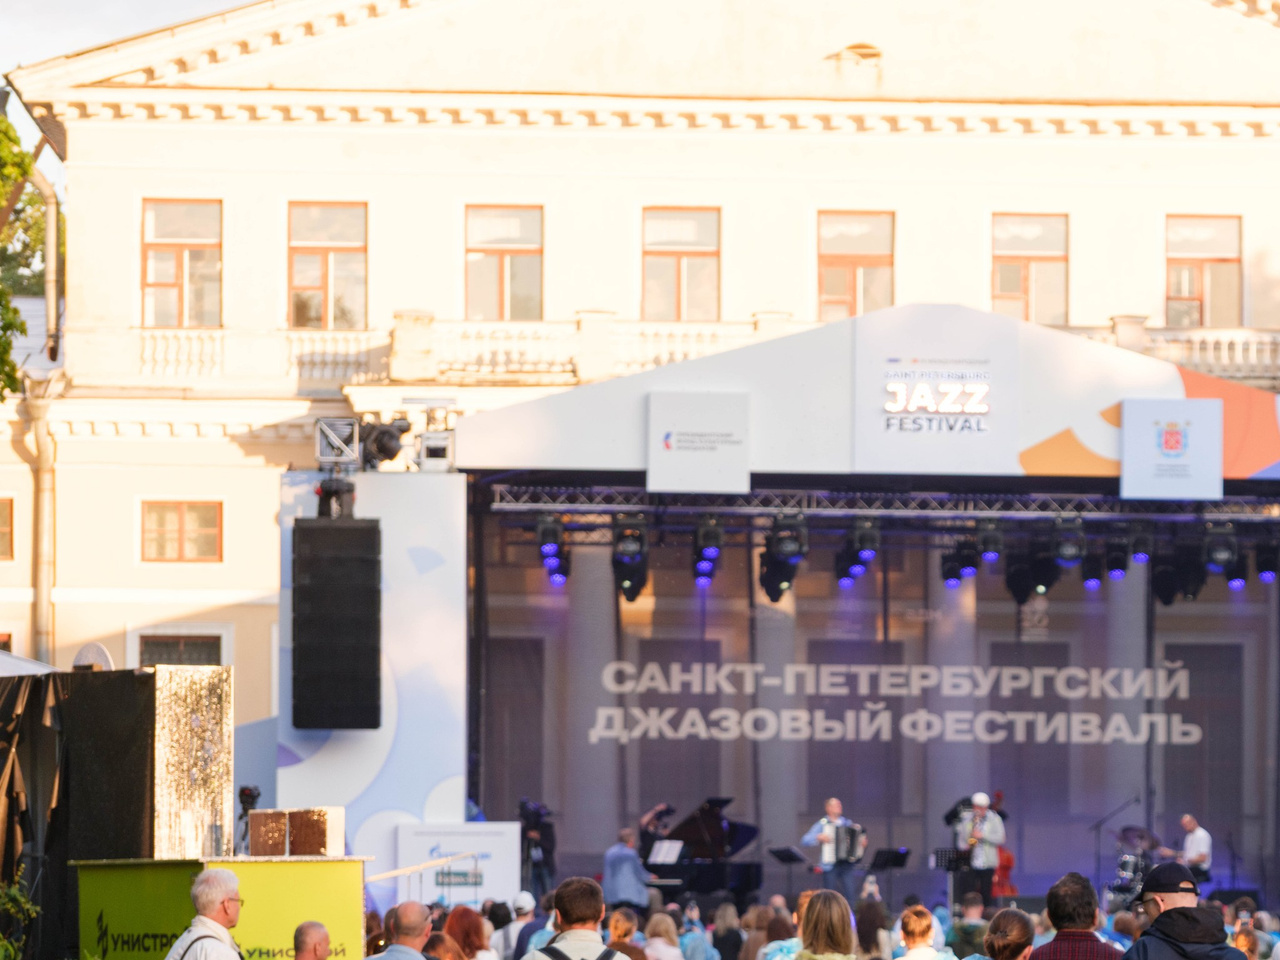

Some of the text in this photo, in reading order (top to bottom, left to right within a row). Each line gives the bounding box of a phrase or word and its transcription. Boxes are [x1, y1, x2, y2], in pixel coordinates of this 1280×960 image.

[884, 382, 990, 414] JAZZ
[885, 416, 987, 432] FESTIVAL
[601, 659, 1191, 700] САНКТ-ПЕТЕРБУРГСКИЙ
[588, 701, 1203, 745] ДЖАЗОВЫЙ ФЕСТИВАЛЬ
